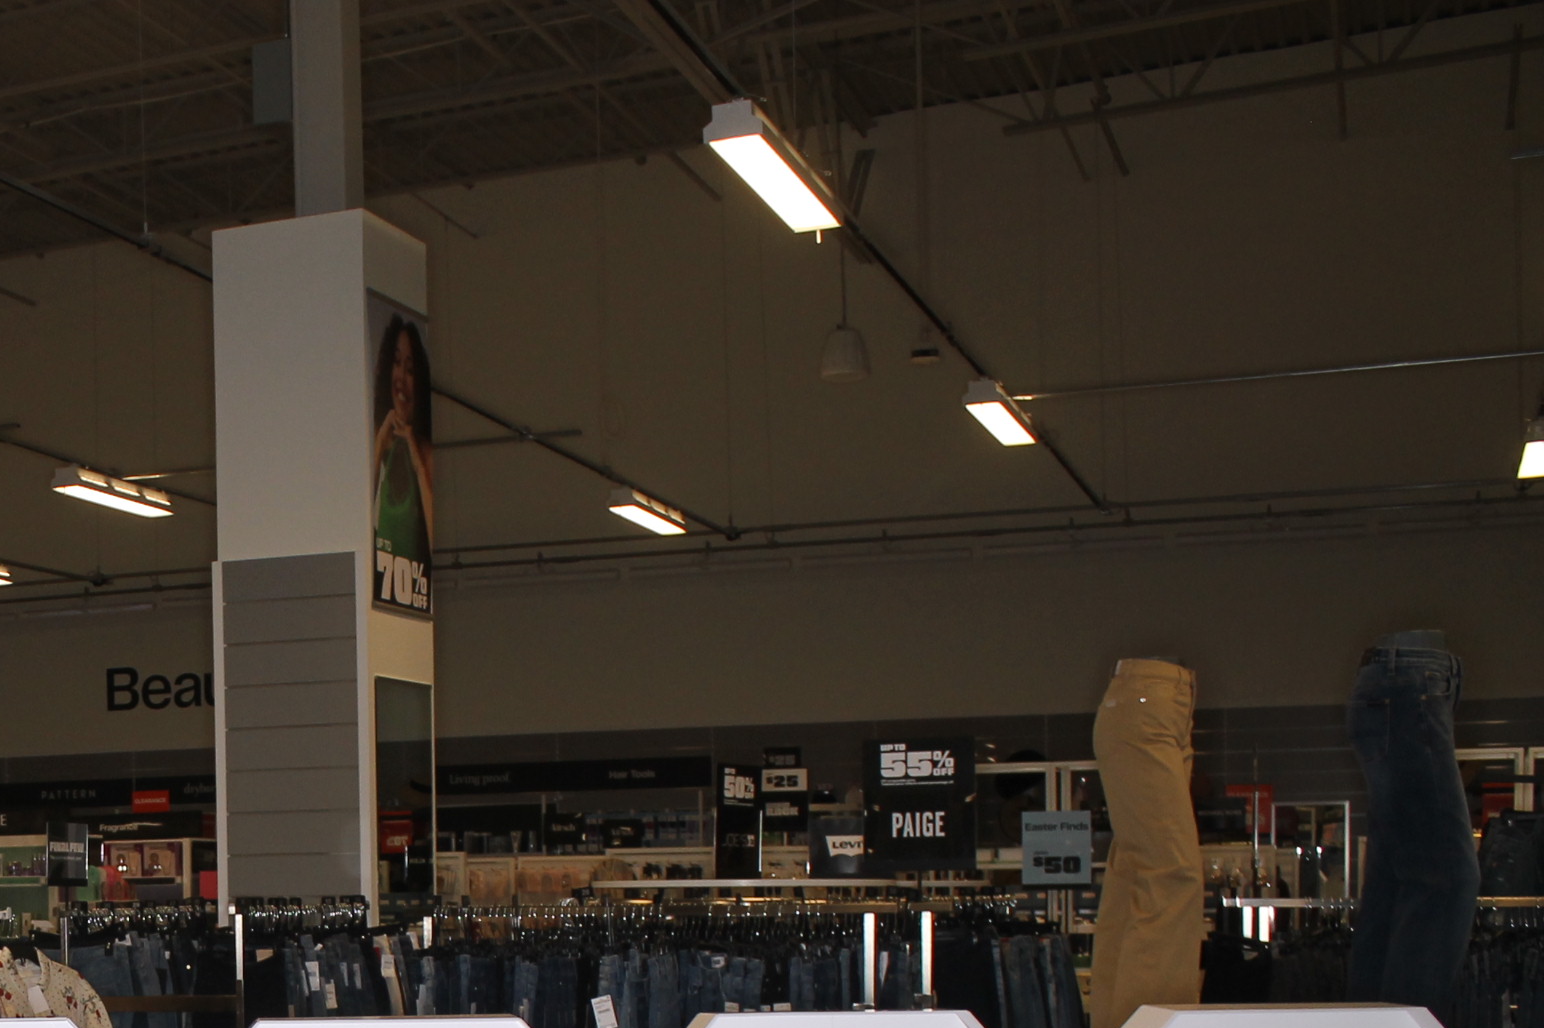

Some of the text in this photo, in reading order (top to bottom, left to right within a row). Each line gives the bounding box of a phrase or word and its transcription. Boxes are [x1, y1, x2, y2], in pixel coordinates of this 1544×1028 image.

[880, 750, 954, 778] 55%
[933, 768, 954, 776] OFF
[766, 775, 798, 788] $25
[41, 789, 96, 800] PATTERN
[891, 811, 946, 838] PAIGE
[1025, 822, 1089, 831] Easter Finds
[1033, 856, 1081, 874] $50
